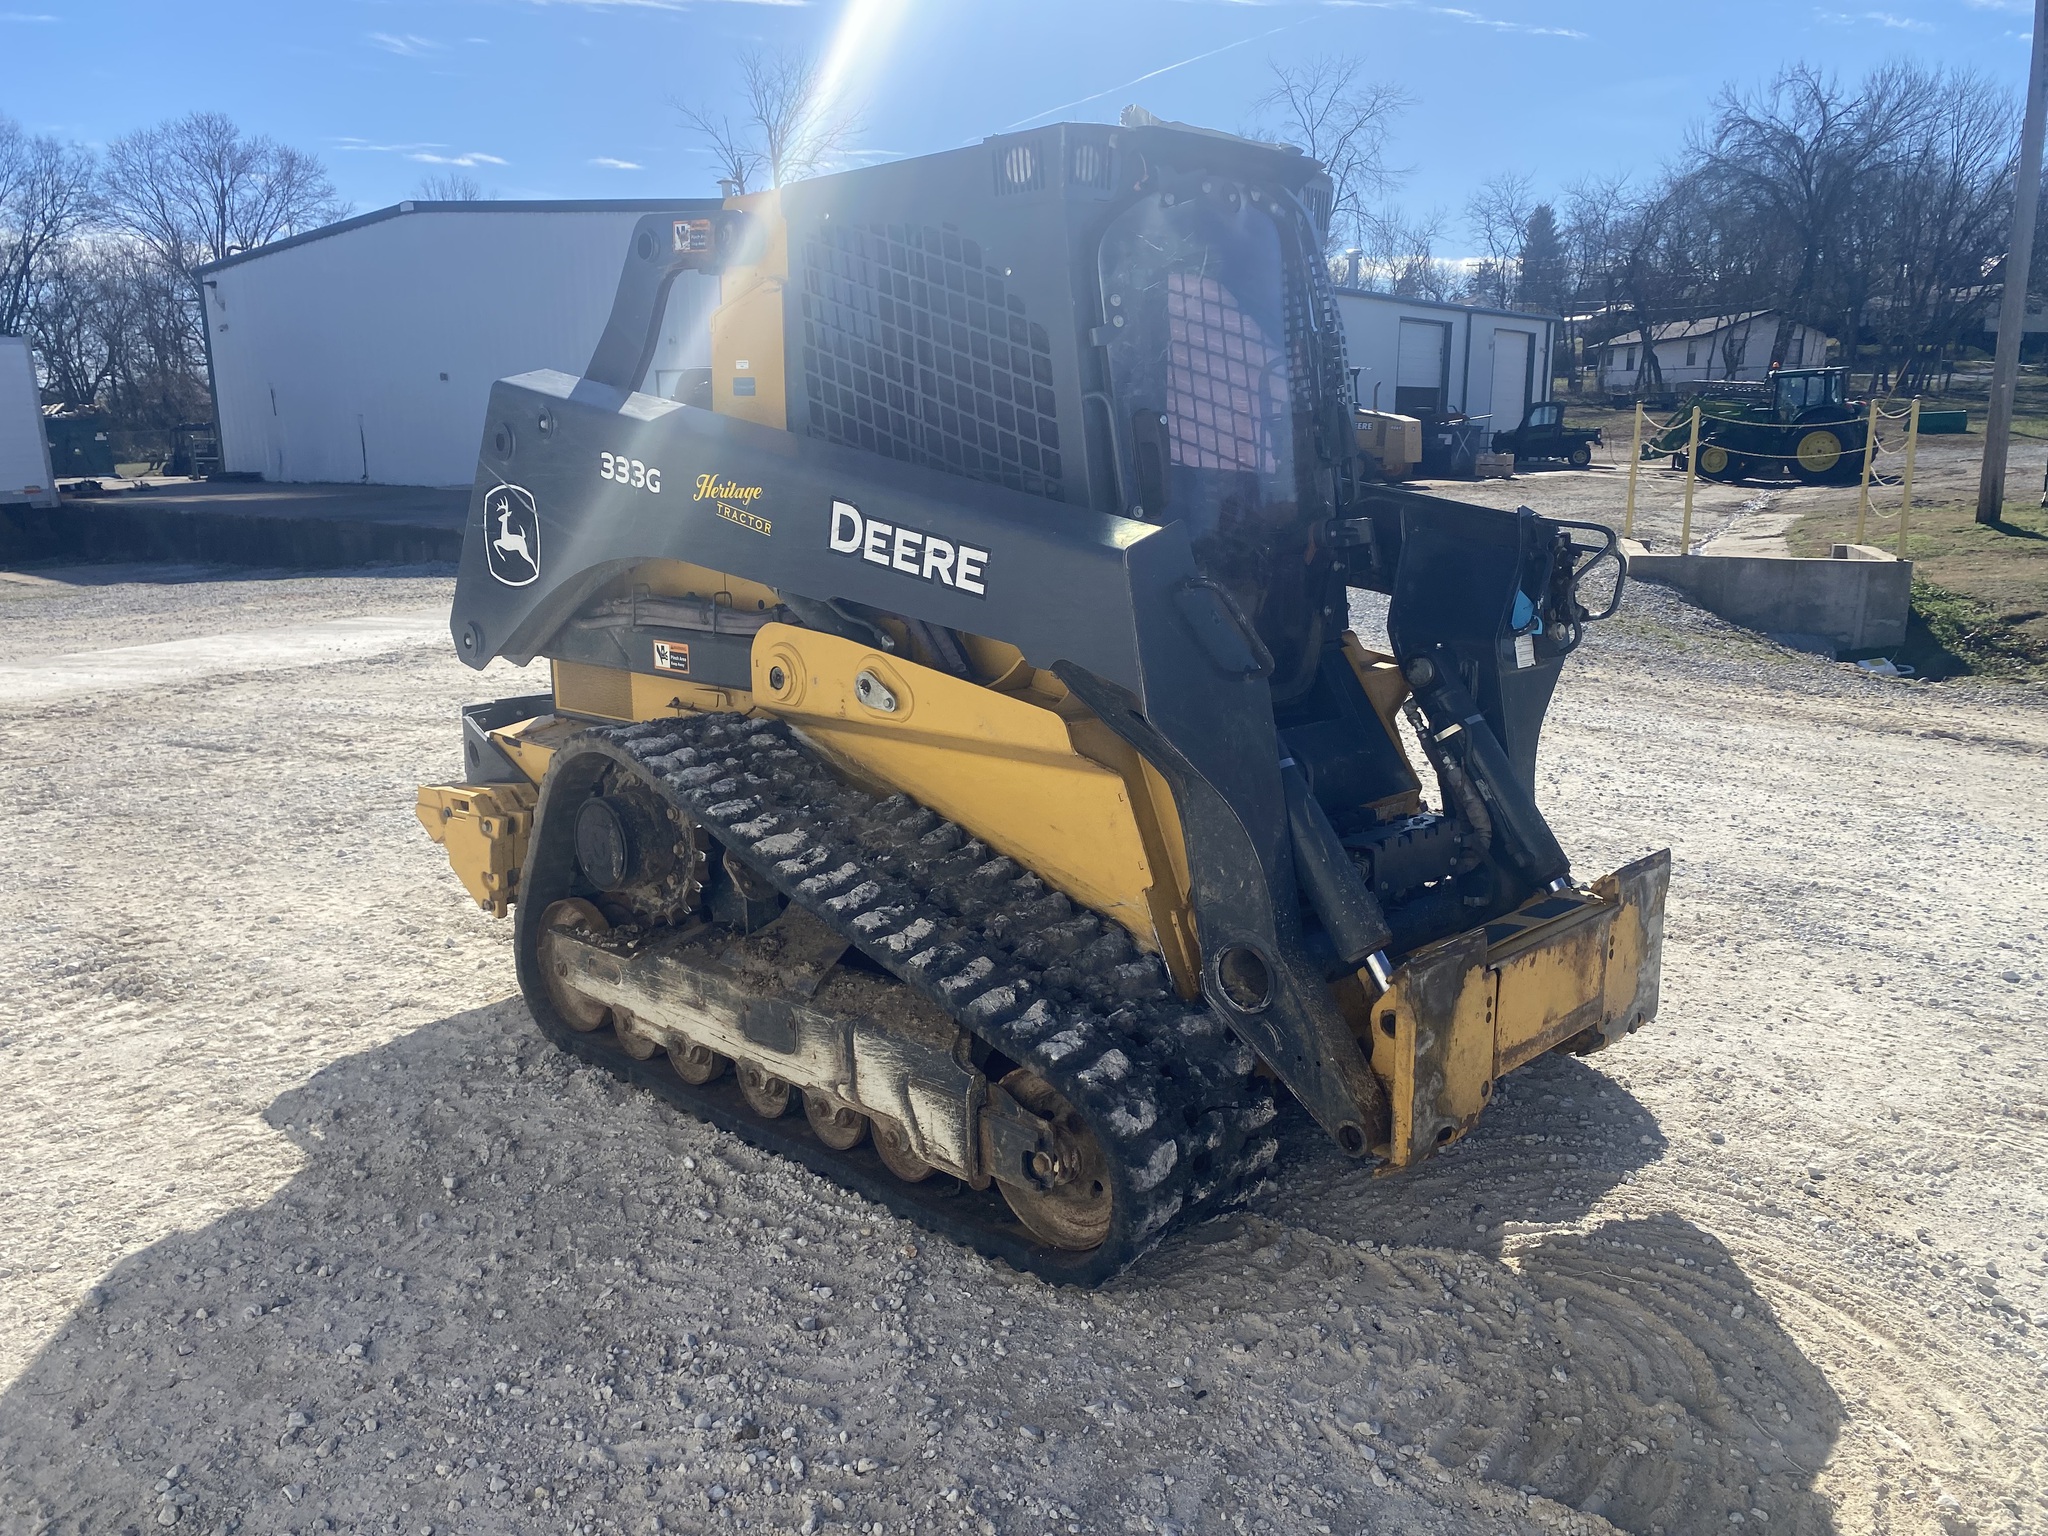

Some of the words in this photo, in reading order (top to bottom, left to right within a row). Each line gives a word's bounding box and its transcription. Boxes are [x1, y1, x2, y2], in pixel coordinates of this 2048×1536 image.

[600, 451, 661, 494] 333G
[693, 473, 763, 506] Heritage
[716, 503, 772, 534] TRACTOR
[830, 500, 989, 596] DEERE
